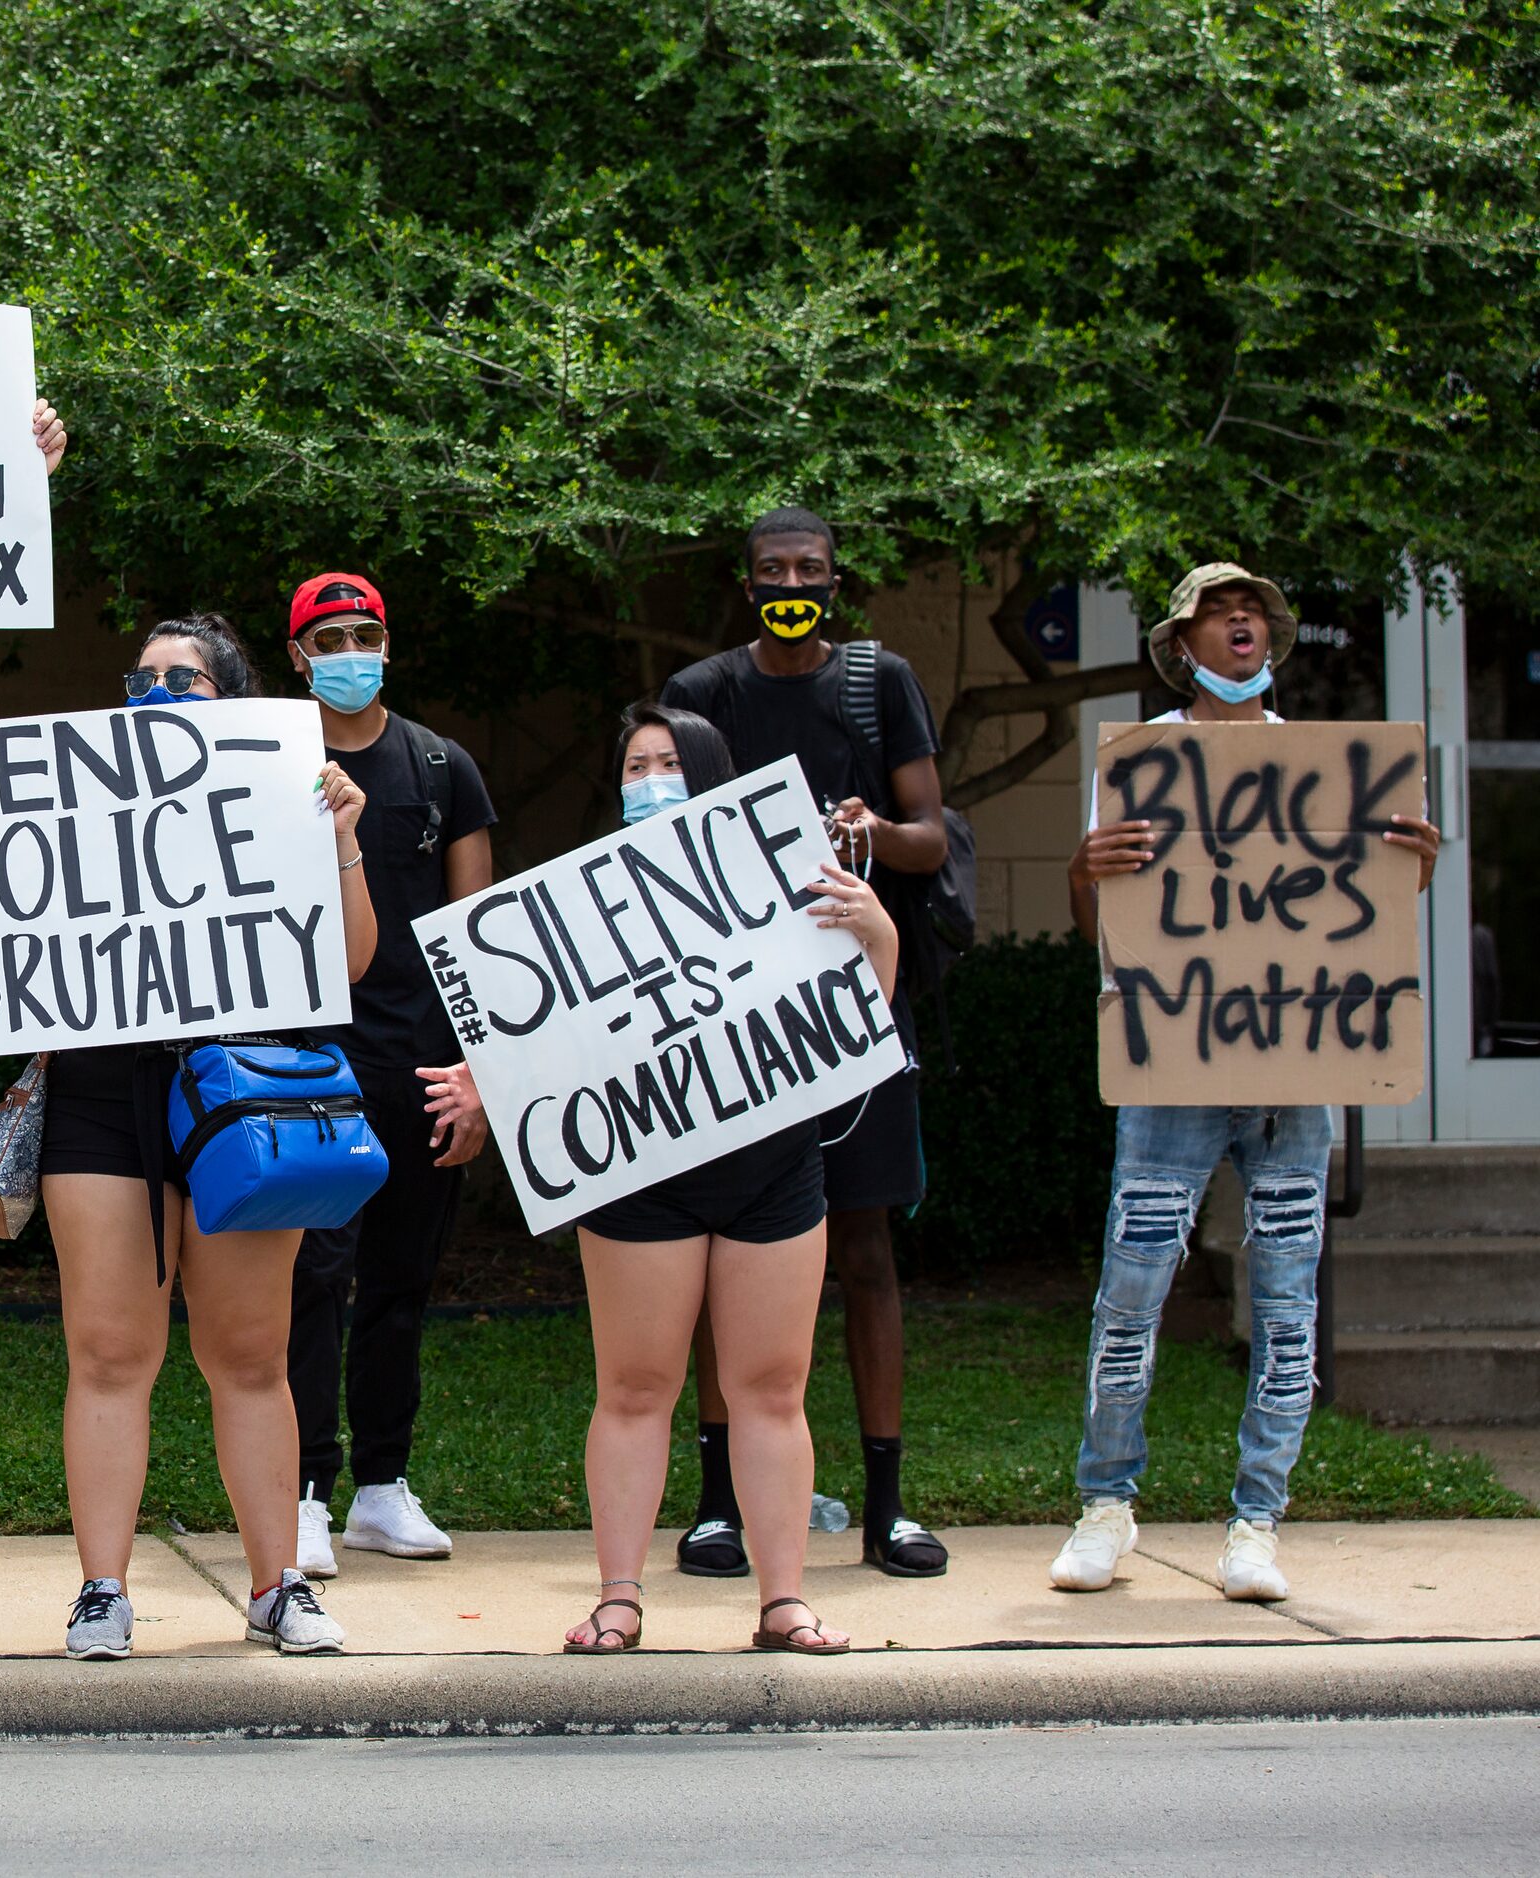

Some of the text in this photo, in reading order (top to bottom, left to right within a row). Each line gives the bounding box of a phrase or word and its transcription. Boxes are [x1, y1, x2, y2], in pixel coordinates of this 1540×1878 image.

[466, 780, 827, 1037] SILENCE
[1160, 851, 1375, 942] Lives
[424, 935, 489, 1046] #BLFM
[1113, 955, 1419, 1066] Matter
[516, 951, 898, 1201] COMPLIANCE
